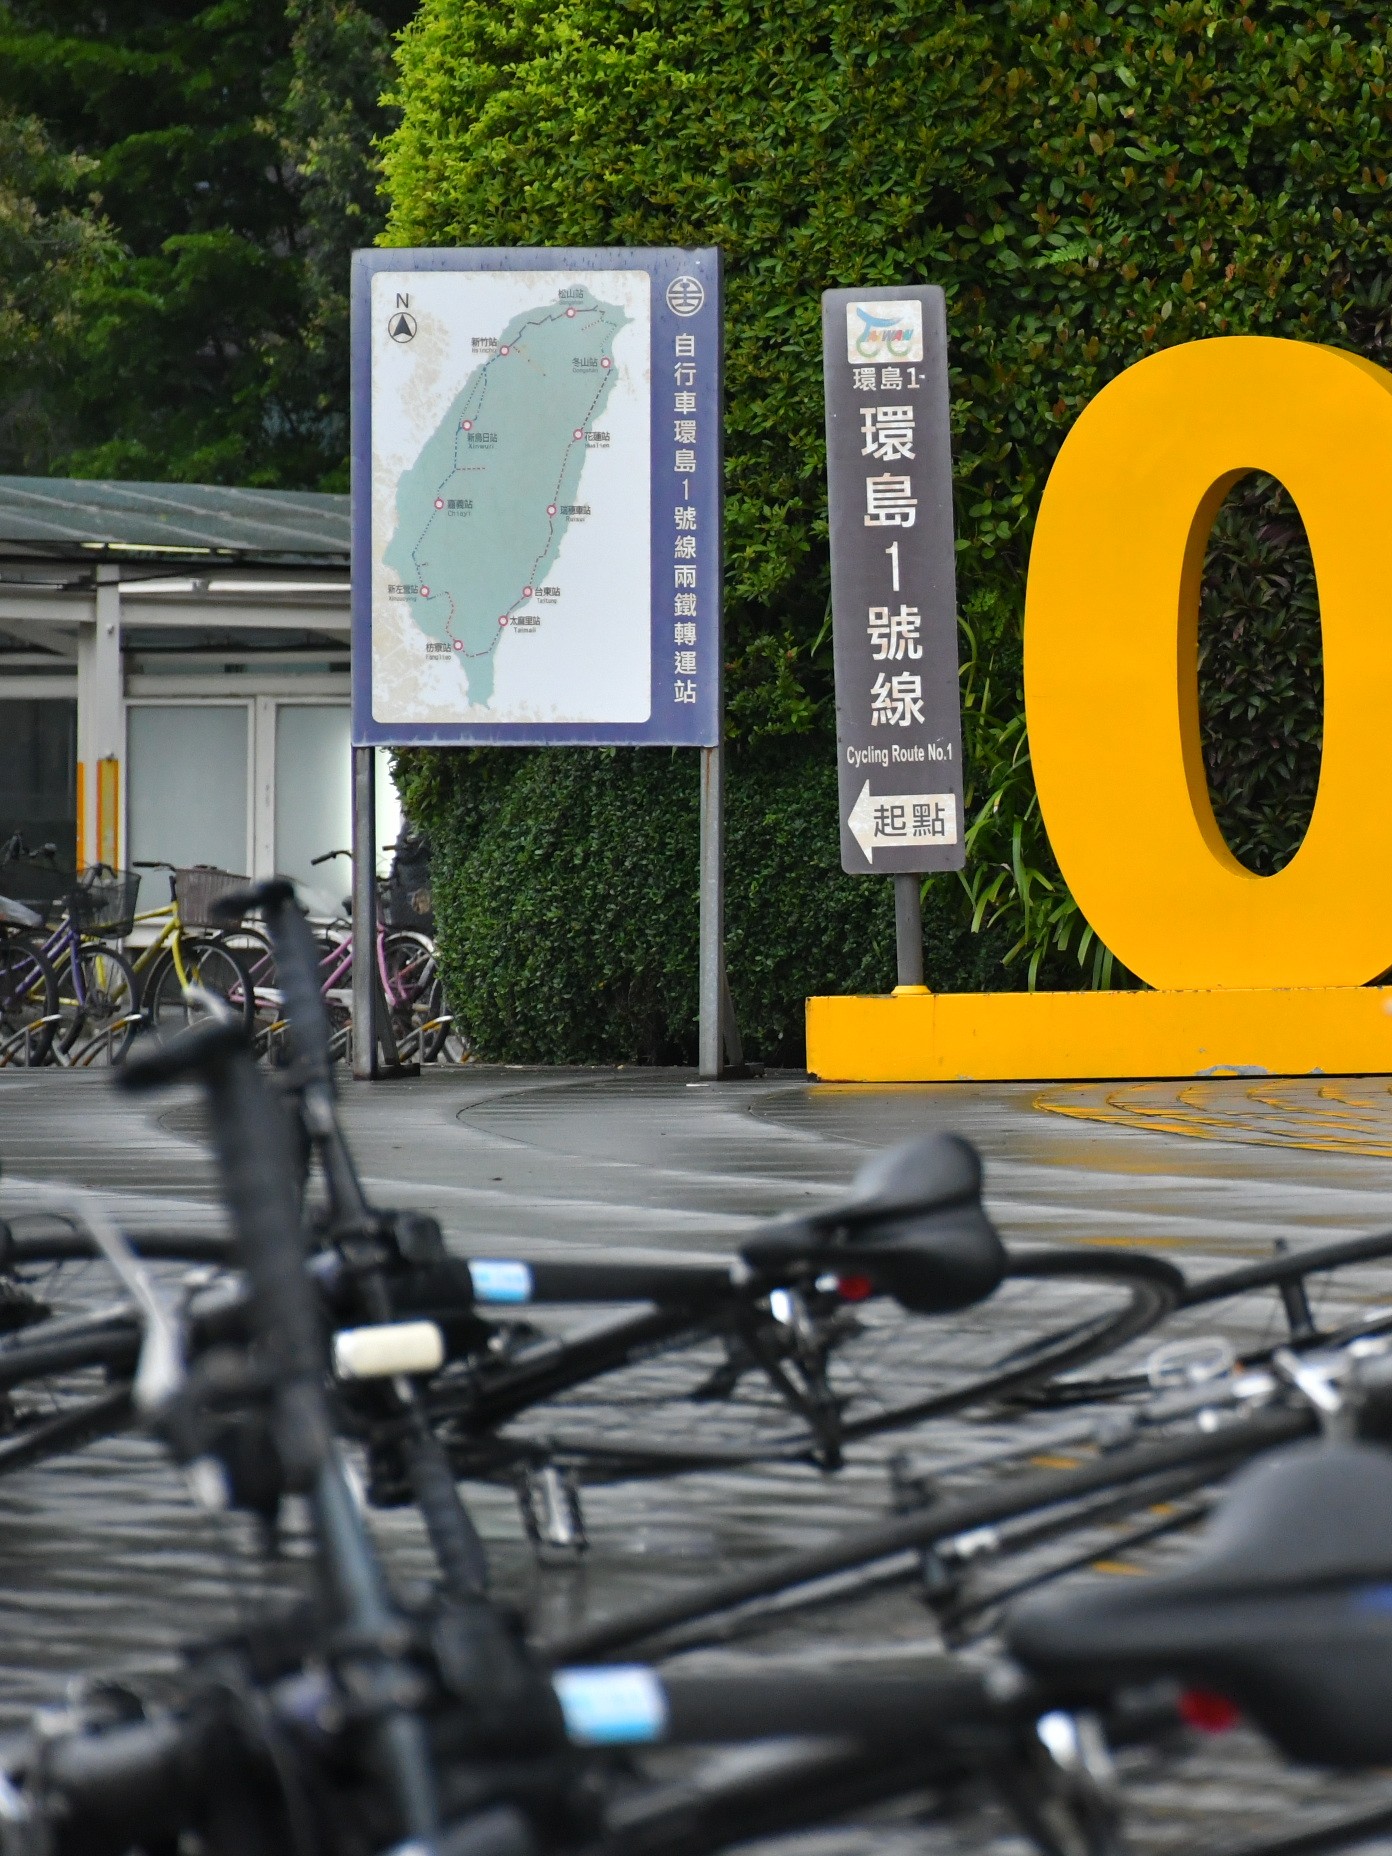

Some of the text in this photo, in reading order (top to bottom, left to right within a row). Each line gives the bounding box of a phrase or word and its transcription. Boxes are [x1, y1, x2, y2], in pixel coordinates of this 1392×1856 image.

[558, 288, 584, 299] 松山站
[396, 293, 409, 308] N
[471, 337, 498, 347] 新竹站
[572, 357, 598, 367] 冬山站
[584, 431, 610, 441] 花蓮站
[673, 332, 697, 704] 自行車環島1號線兩鐵轉運站
[860, 405, 925, 727] 環島1號線
[534, 586, 561, 596] 台東站
[509, 615, 541, 625] 太麻里站
[846, 742, 952, 768] Cycling Route No.1
[873, 802, 946, 837] 起點
